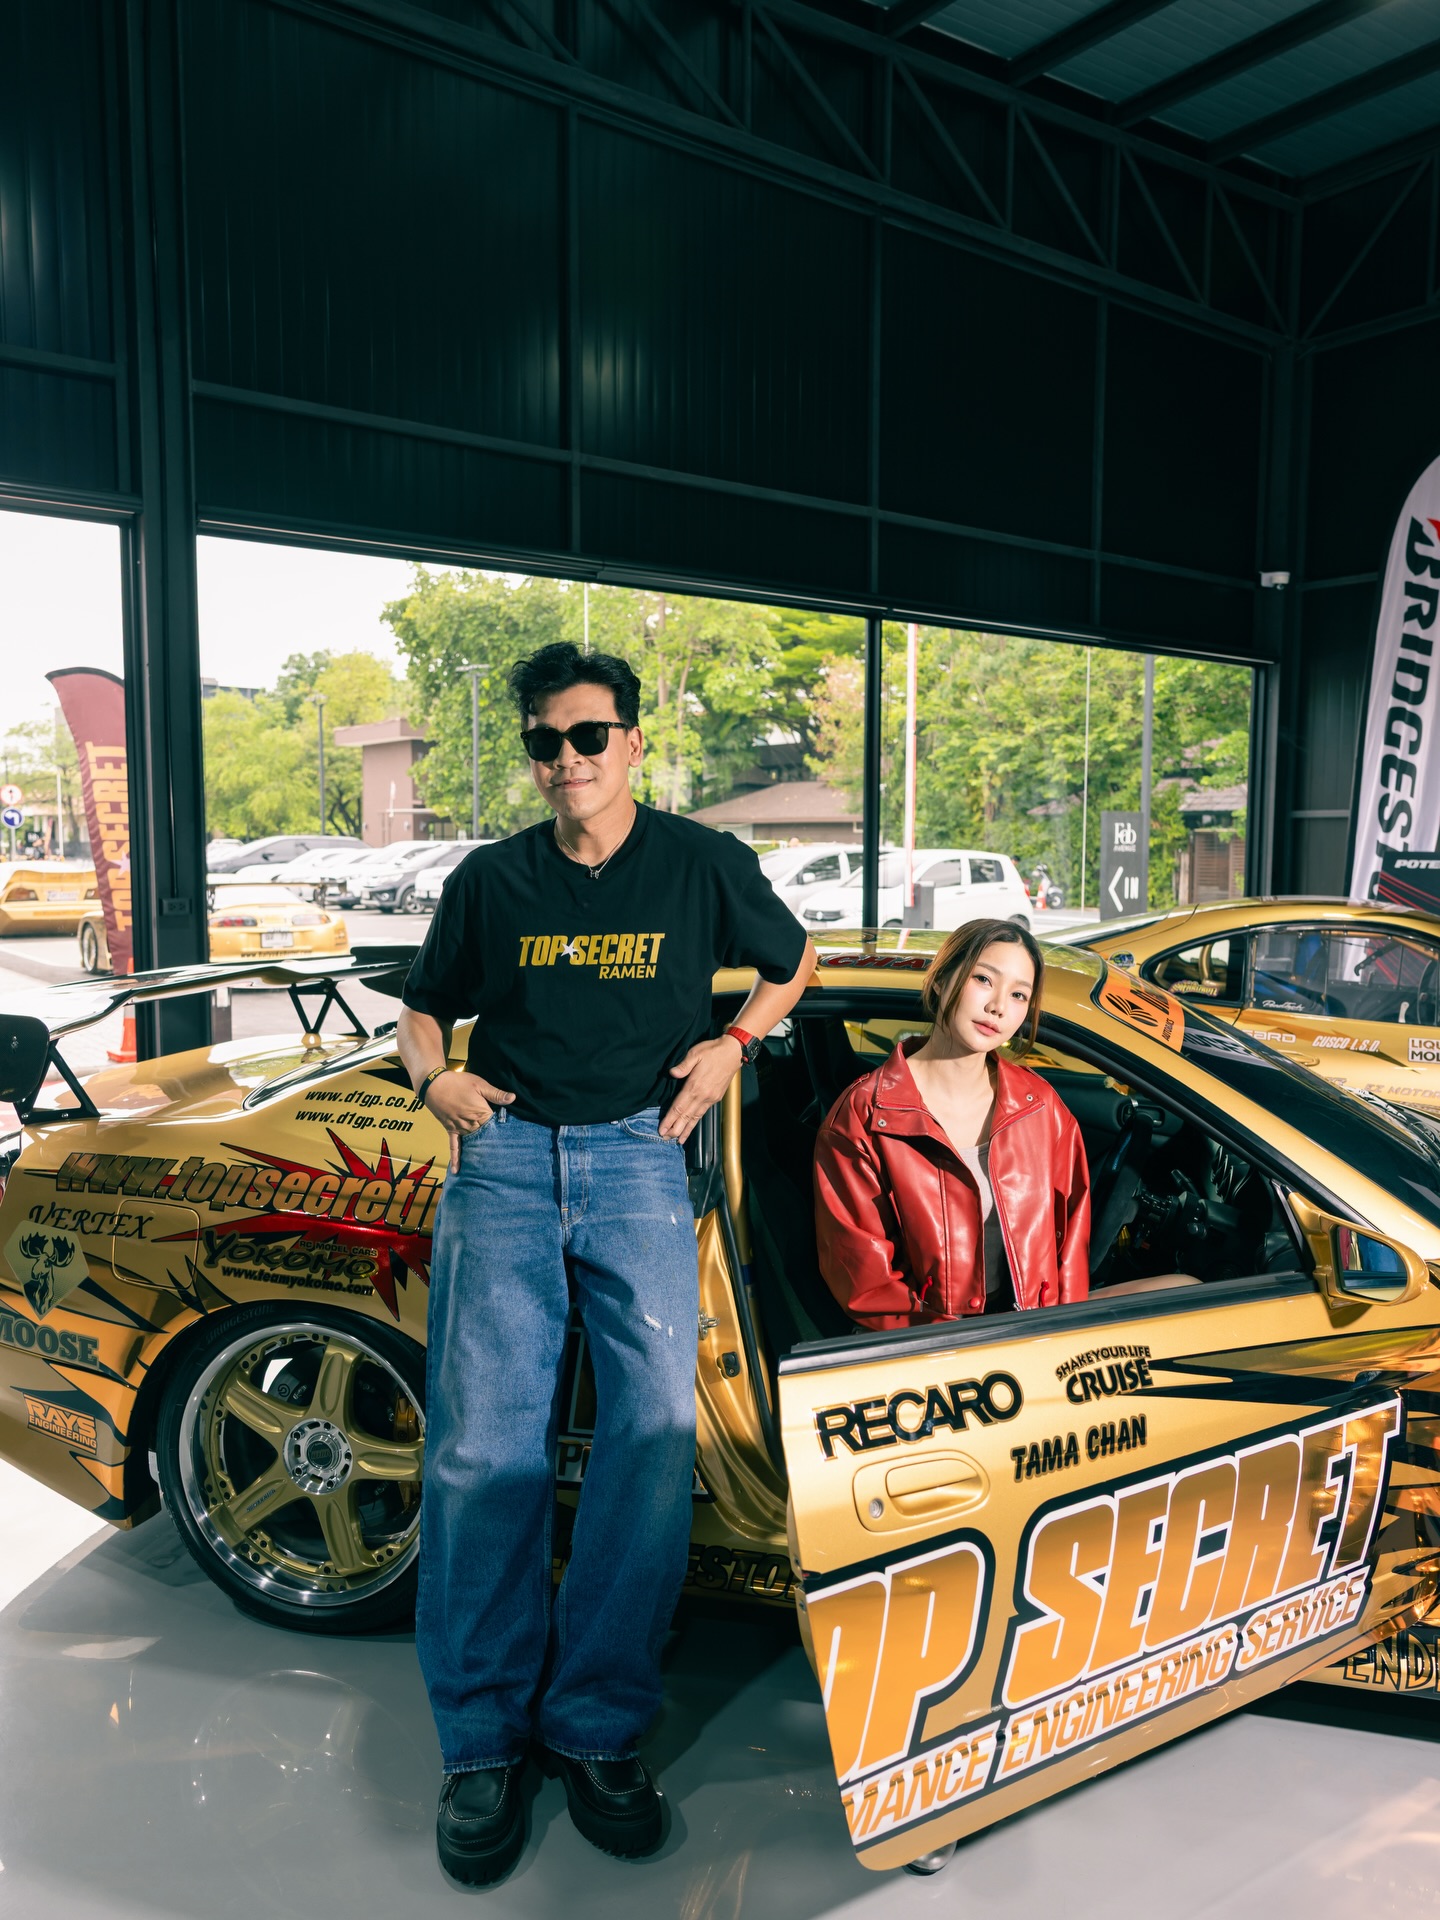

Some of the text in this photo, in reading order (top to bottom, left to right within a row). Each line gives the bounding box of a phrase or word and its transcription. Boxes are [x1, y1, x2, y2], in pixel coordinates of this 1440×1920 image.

[86, 741, 130, 864] SECRET
[1124, 876, 1139, 899] IN
[518, 932, 665, 967] TOP SECRET
[598, 964, 657, 979] RAMEN
[1312, 1035, 1351, 1050] CUSCO
[305, 1090, 425, 1113] www.d1gp.co.jp
[295, 1110, 414, 1132] www.d1gp.com
[28, 1201, 154, 1240] VERTEX
[300, 1239, 378, 1257] RC MODEL CARS
[222, 1265, 376, 1296] www.teamyokomo.com
[1065, 1358, 1154, 1405] CRUISE
[25, 1398, 97, 1440] RAYS
[28, 1415, 97, 1448] ENGINEERING
[815, 1370, 1024, 1461] RECARO
[1010, 1413, 1148, 1482] TAMA CHAN
[1002, 1398, 1401, 1708] SECRET
[1000, 1628, 1236, 1777] ENGINEERING
[1240, 1573, 1366, 1668] SERVICE
